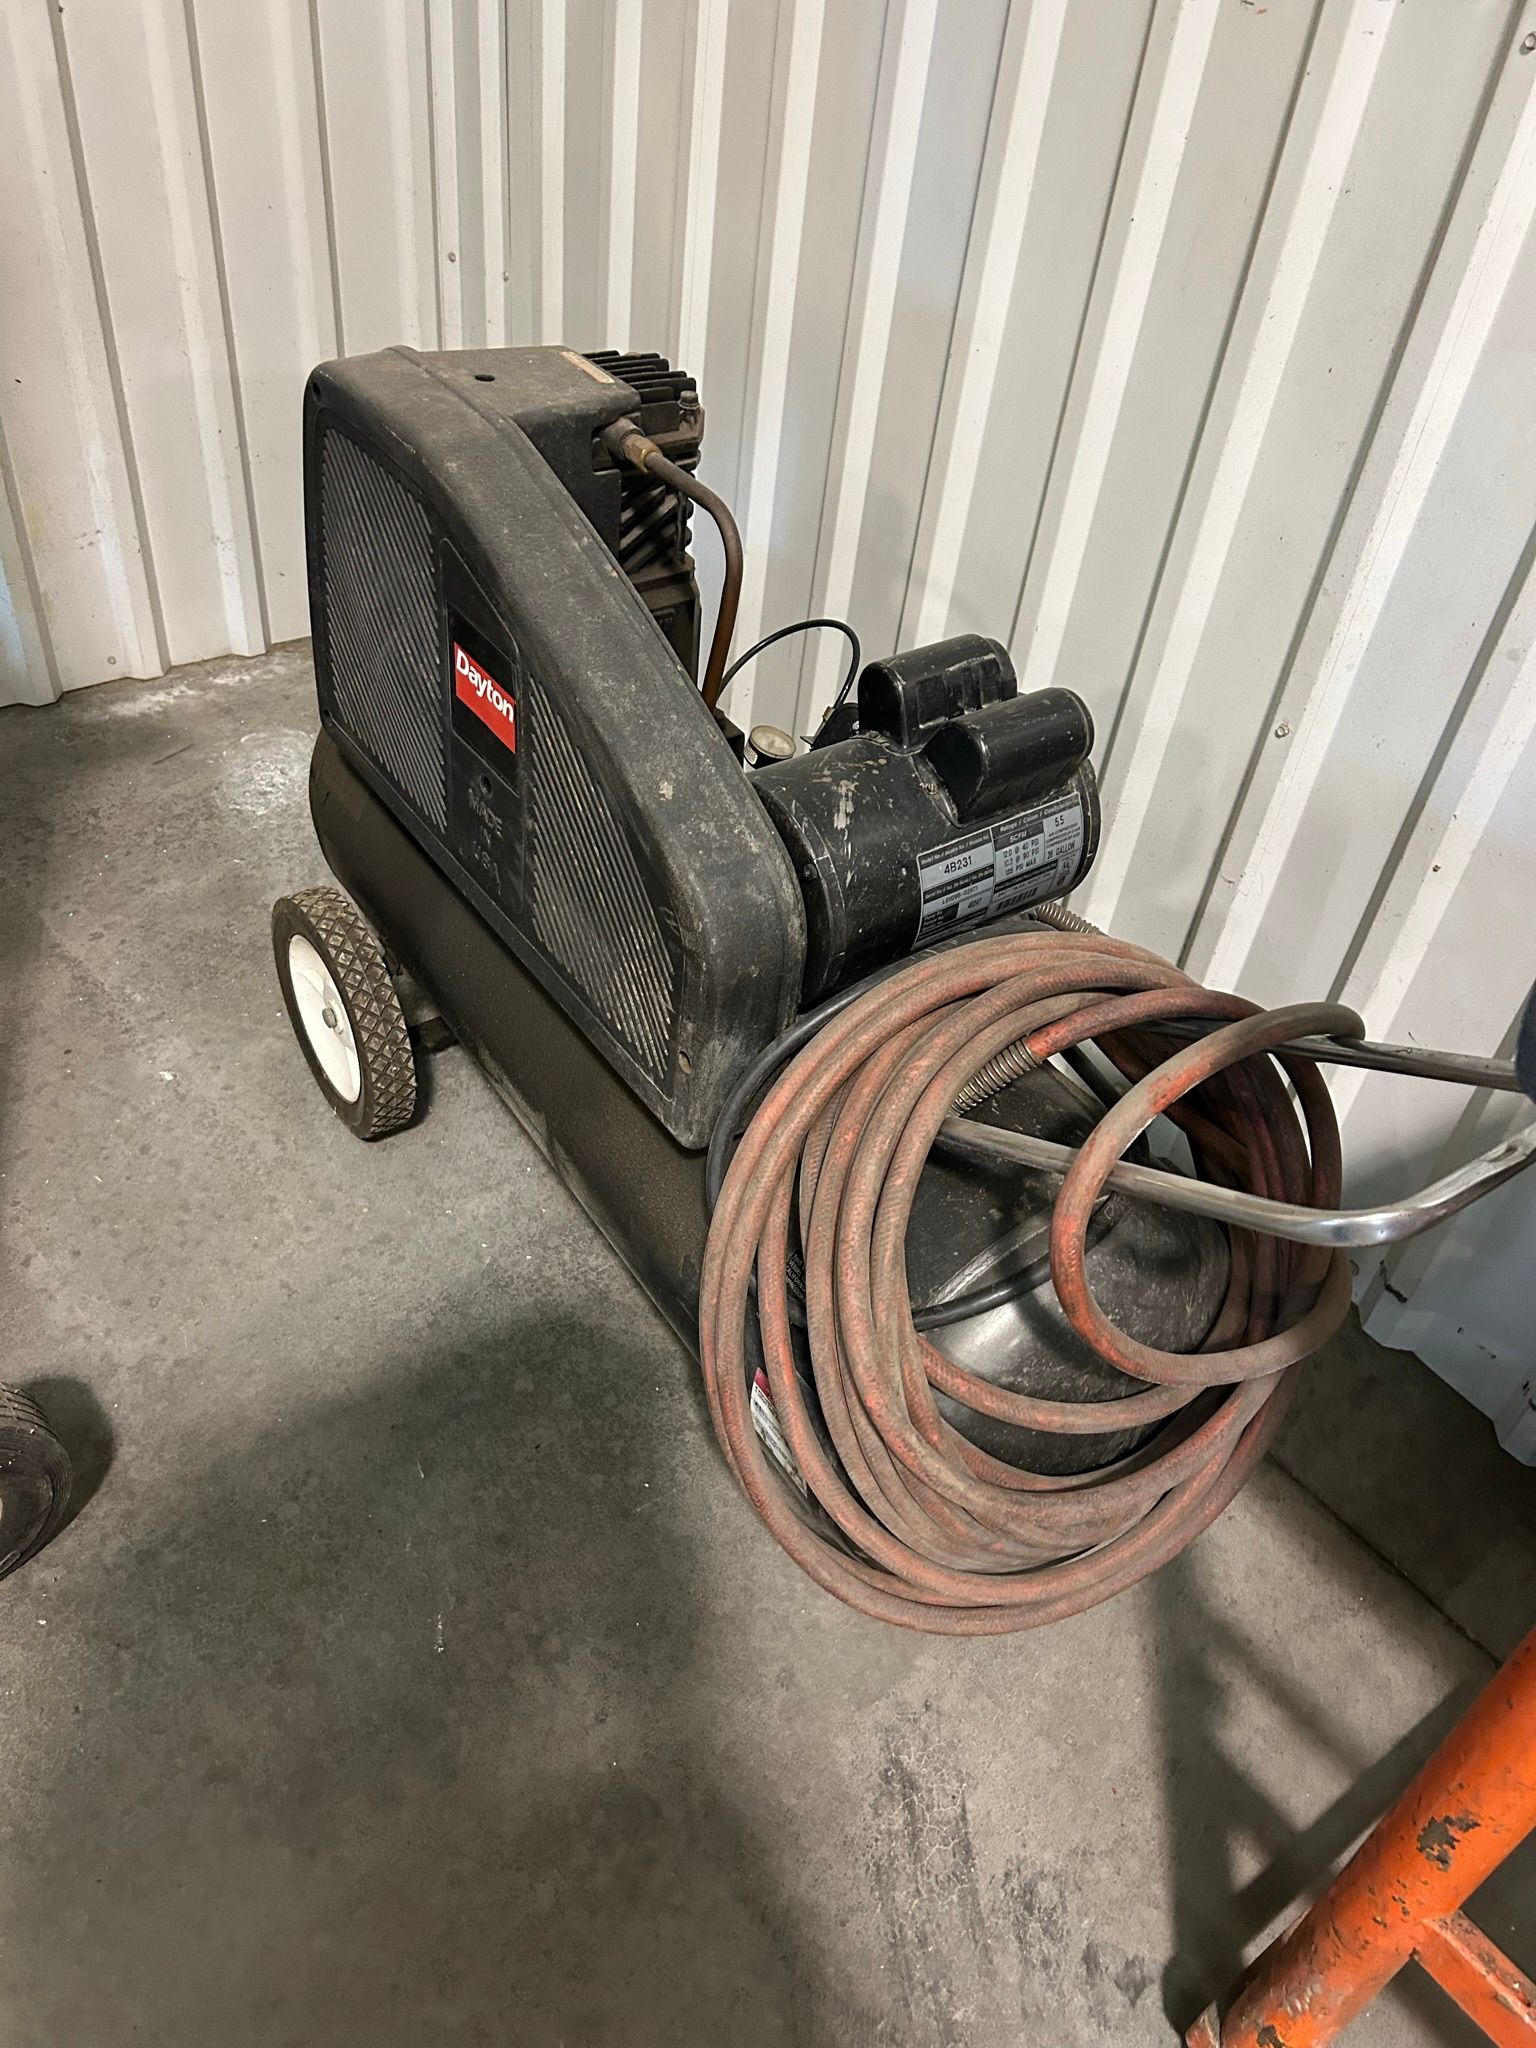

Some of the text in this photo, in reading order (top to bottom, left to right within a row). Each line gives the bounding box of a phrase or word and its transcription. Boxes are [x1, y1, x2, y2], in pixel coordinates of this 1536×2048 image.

[456, 648, 514, 723] Dayton
[1009, 830, 1027, 843] SCFM
[1056, 842, 1075, 855] GALLON
[944, 856, 972, 874] 4B231
